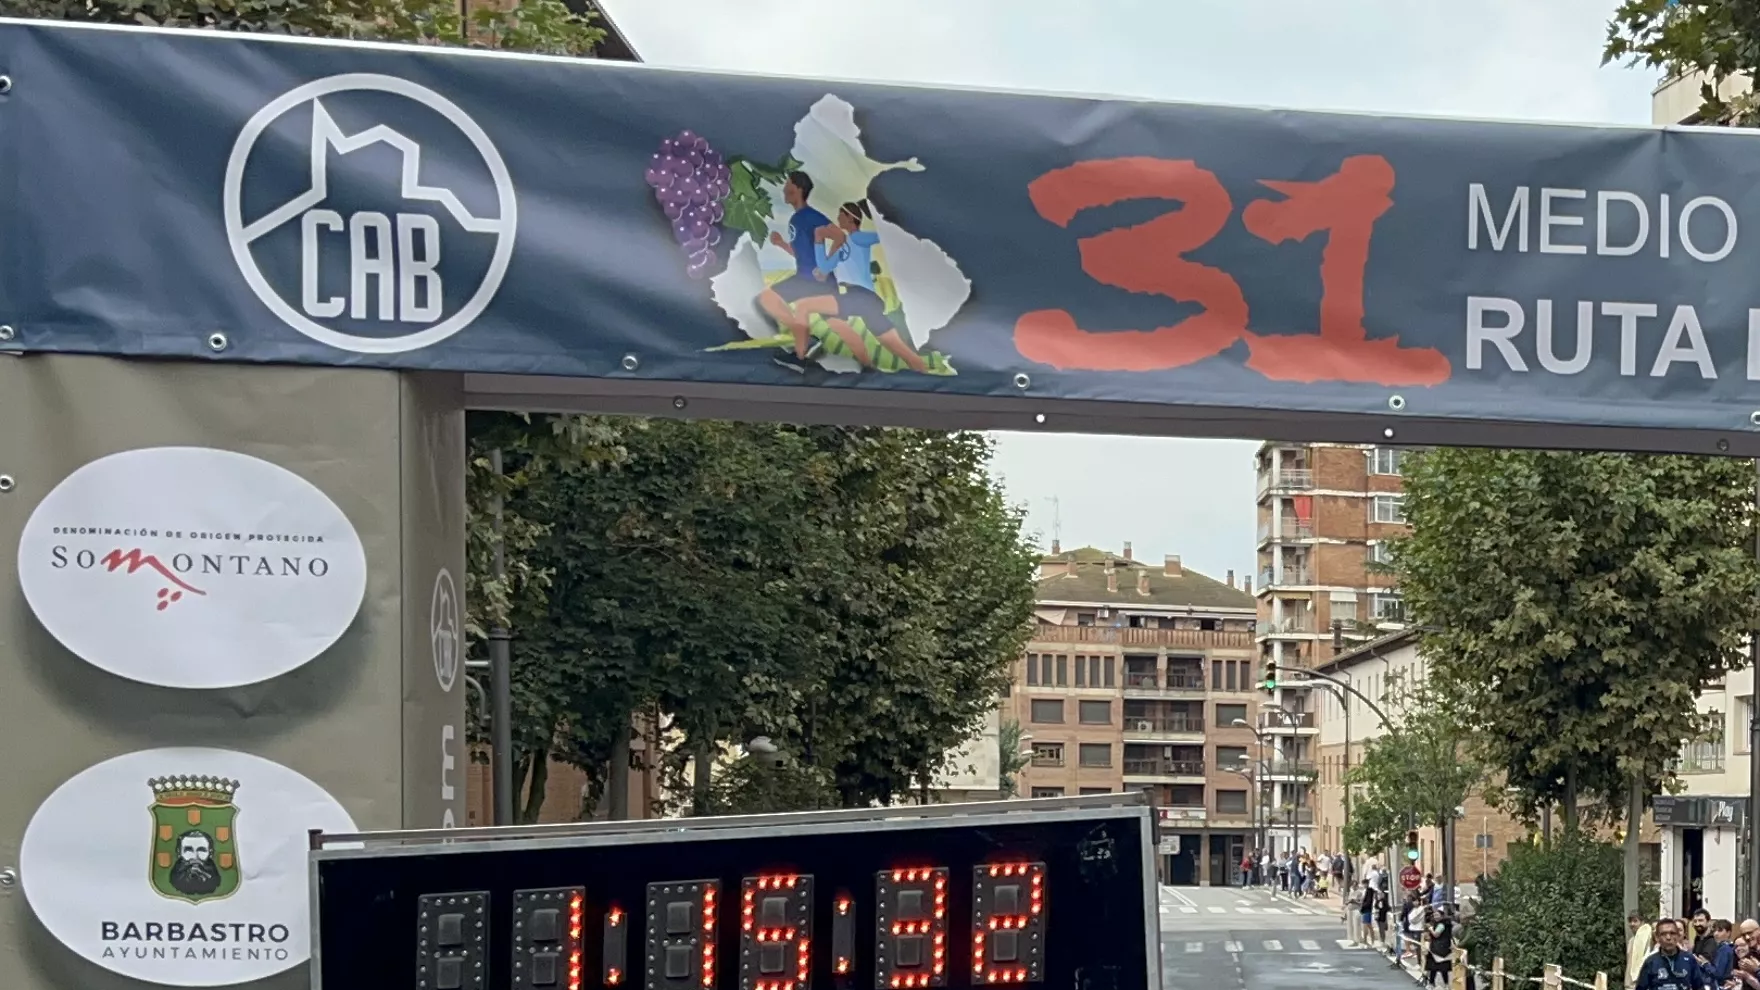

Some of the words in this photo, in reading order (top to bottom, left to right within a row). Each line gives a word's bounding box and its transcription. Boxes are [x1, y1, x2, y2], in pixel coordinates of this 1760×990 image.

[1467, 182, 1738, 263] MEDIO
[301, 209, 443, 324] CAB
[1013, 154, 1451, 388] 31
[1464, 296, 1718, 380] RUTA
[53, 526, 159, 537] DENOMINACIÓN
[166, 531, 184, 539] DE
[190, 532, 242, 541] ORIGEN
[248, 534, 326, 543] PROTEGIDA
[101, 921, 290, 944] BARBASTRO
[101, 946, 289, 962] AYUNTAMIENTO
